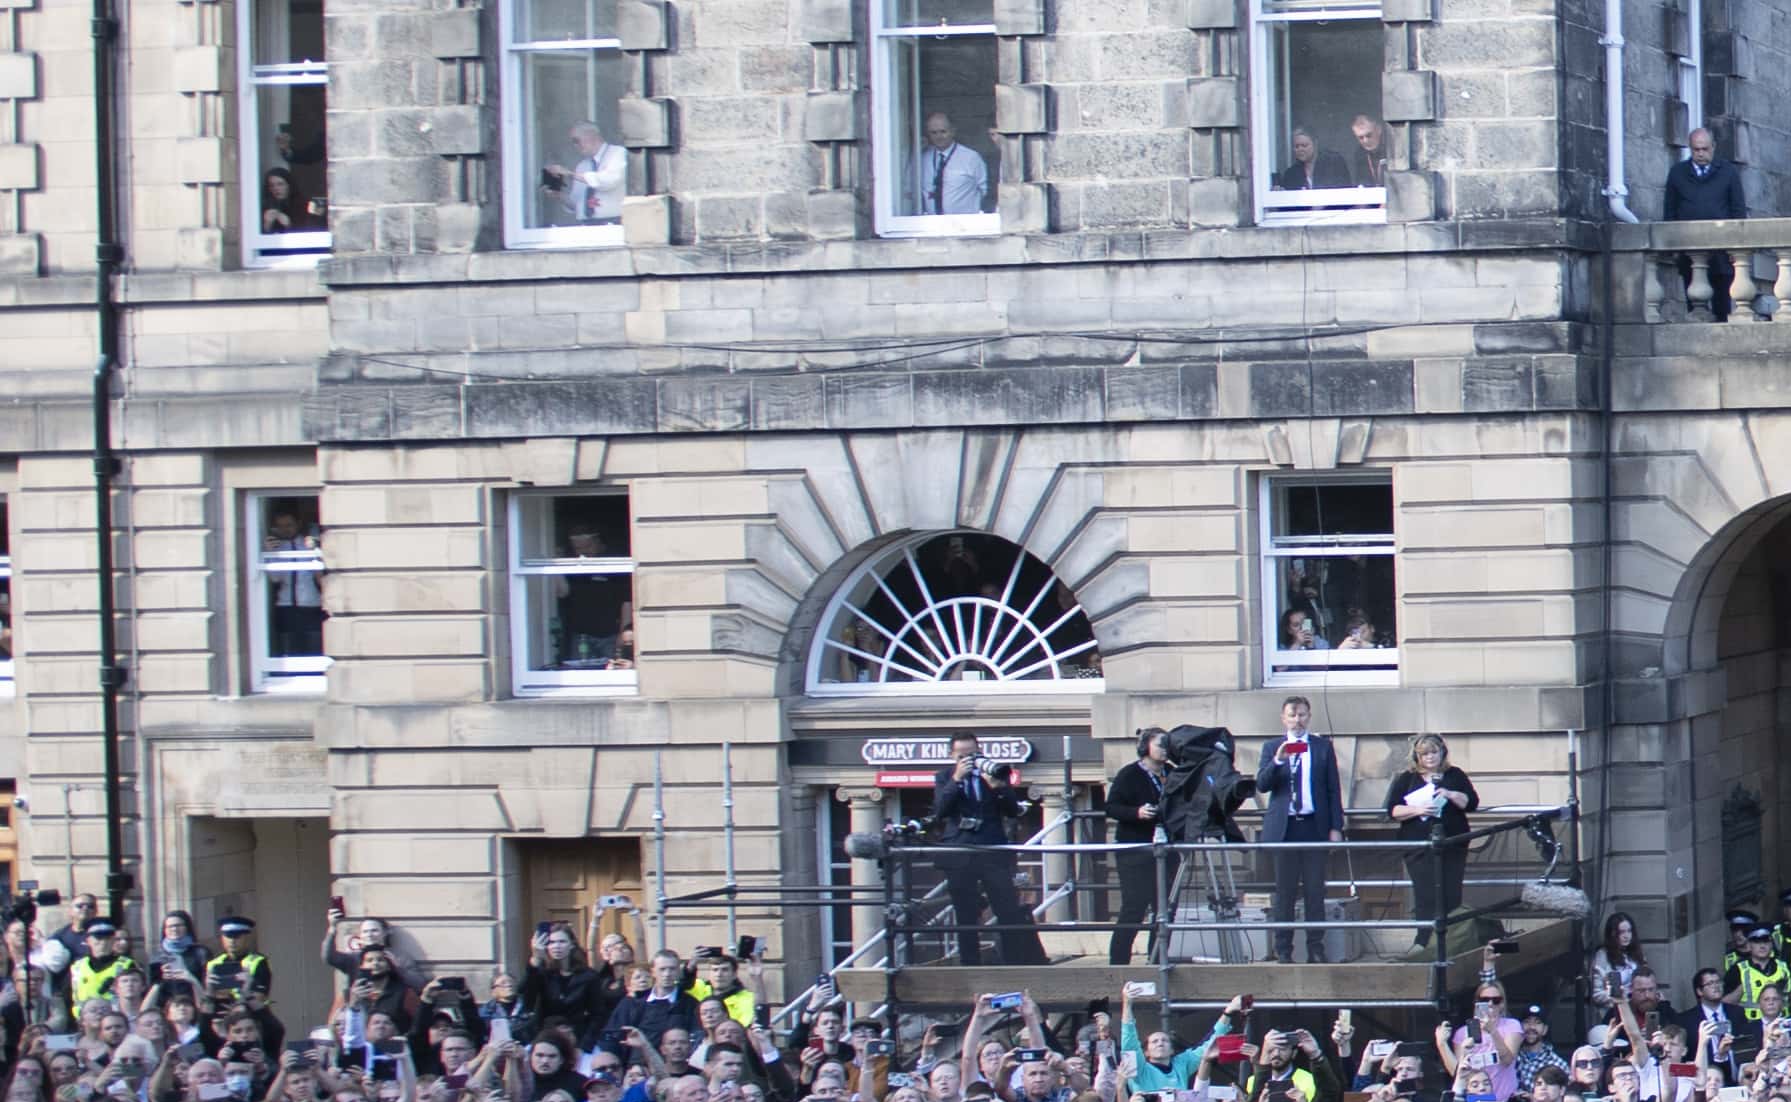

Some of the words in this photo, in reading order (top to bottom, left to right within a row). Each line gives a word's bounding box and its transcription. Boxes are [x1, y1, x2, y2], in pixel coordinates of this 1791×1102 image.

[872, 743, 916, 760] MARY
[921, 743, 948, 759] KIN
[978, 742, 1020, 758] LOSE
